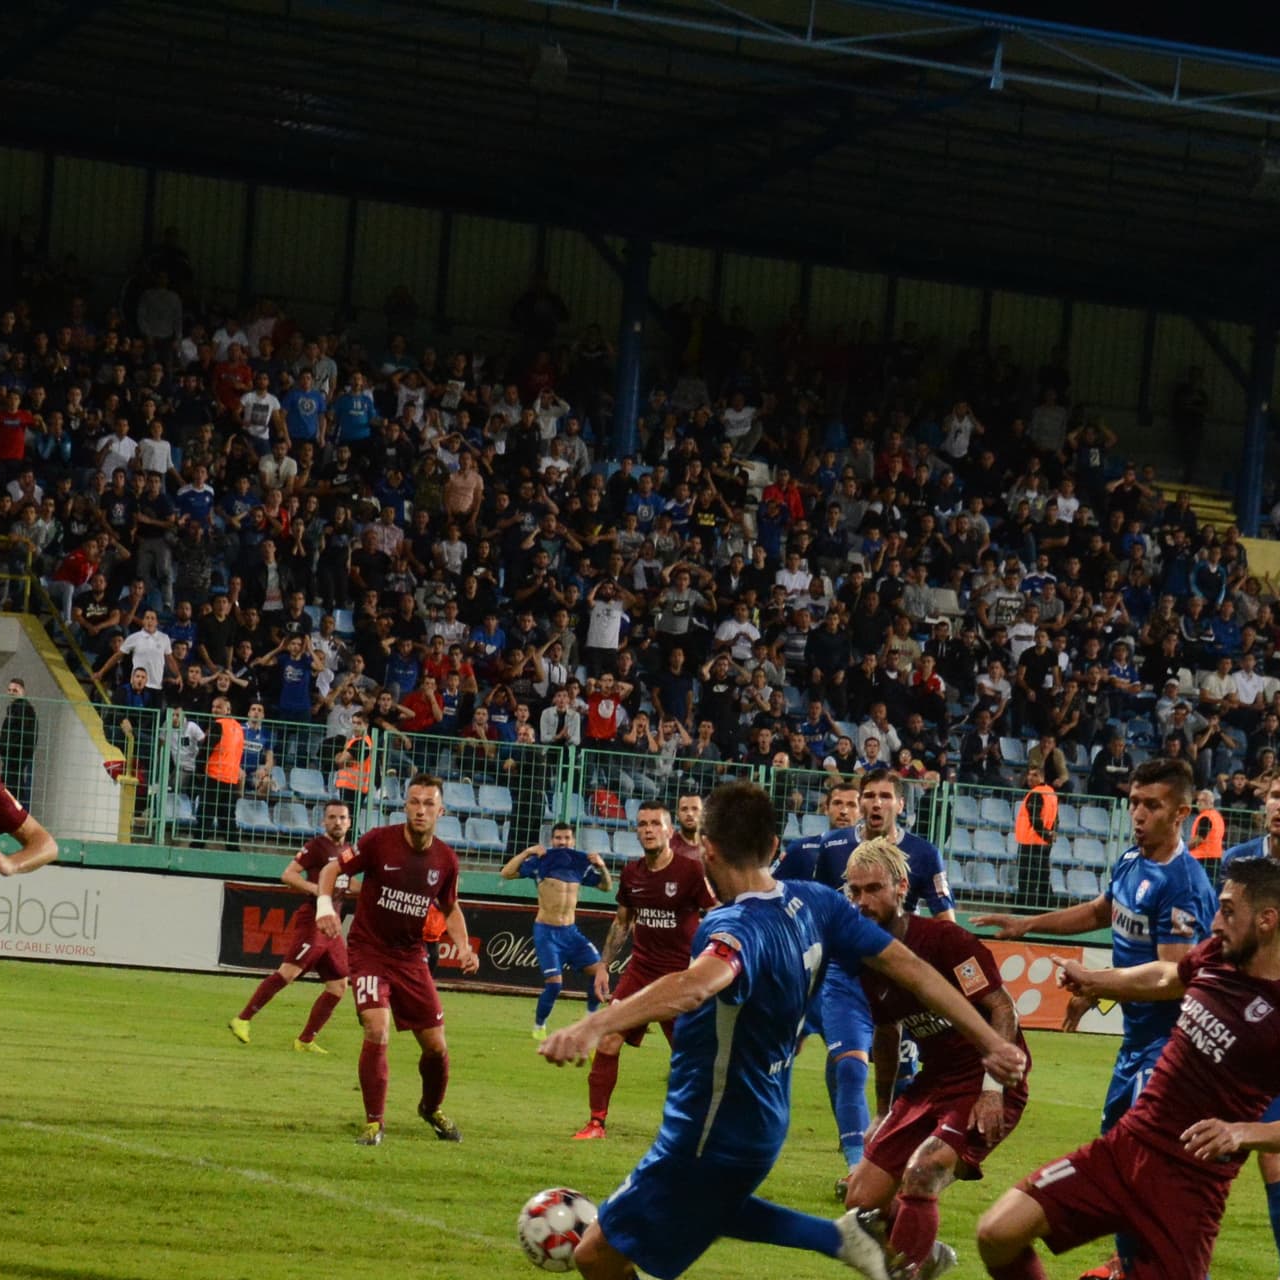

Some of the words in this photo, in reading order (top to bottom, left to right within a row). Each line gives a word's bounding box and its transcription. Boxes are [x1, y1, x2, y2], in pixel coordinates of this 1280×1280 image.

[376, 896, 428, 918] AIRLINES
[381, 886, 430, 907] TURKISH
[634, 907, 677, 919] URKISH
[15, 942, 52, 955] CABLE
[54, 944, 97, 957] WORKS
[295, 943, 311, 961] 7
[356, 975, 379, 1005] 24
[1181, 994, 1238, 1050] URKISH
[1033, 1157, 1077, 1189] 4
